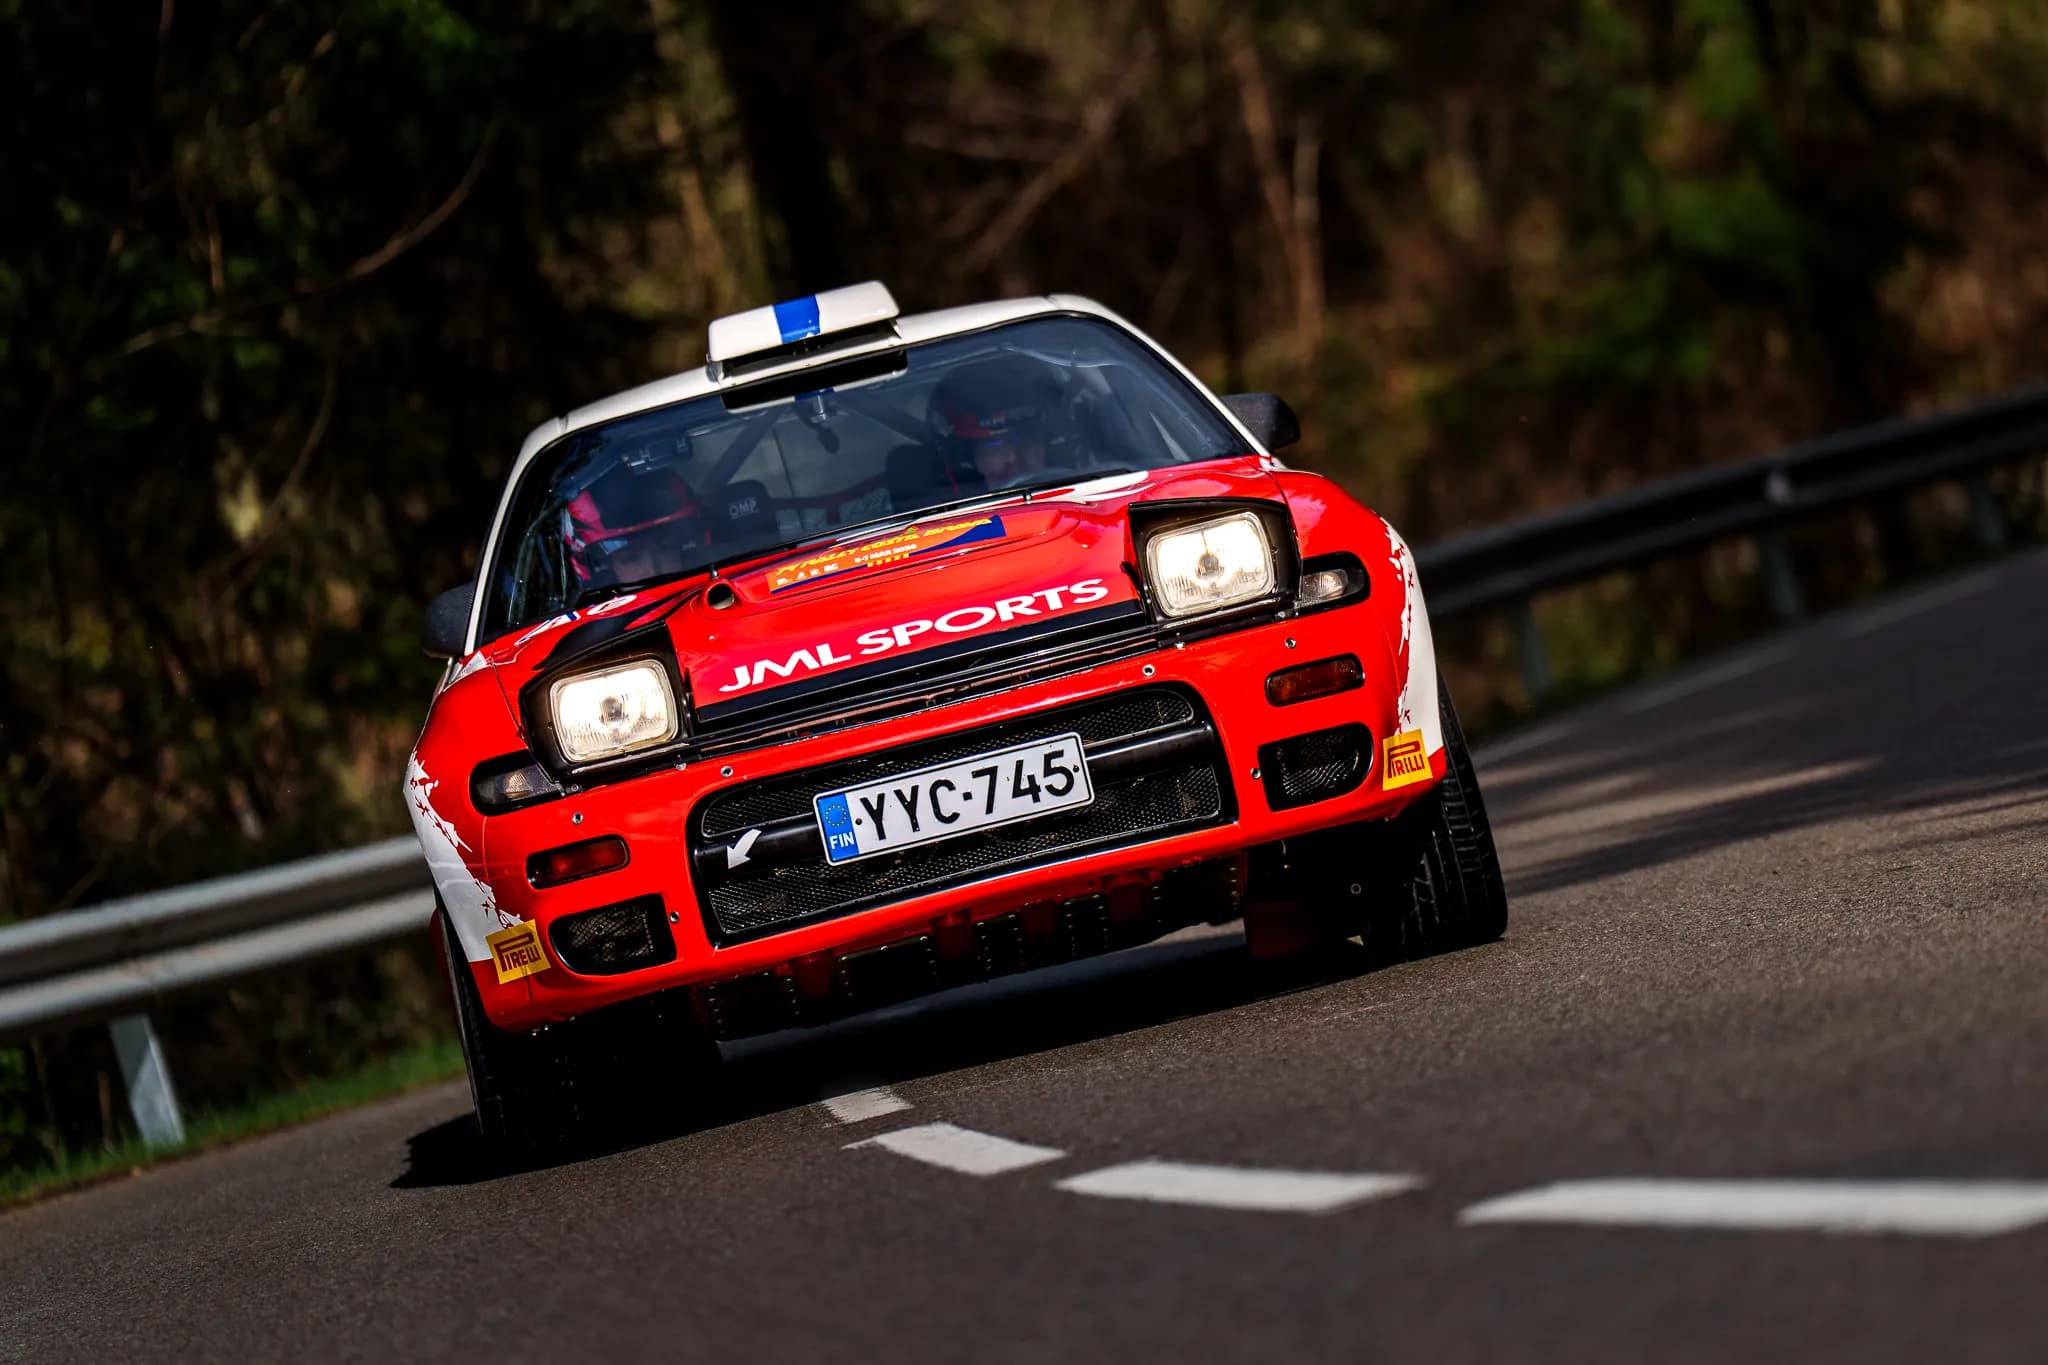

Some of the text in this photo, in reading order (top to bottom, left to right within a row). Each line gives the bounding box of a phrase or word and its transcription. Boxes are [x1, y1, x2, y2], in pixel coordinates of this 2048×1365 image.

[719, 578, 1108, 692] JML SPORTS
[829, 749, 1075, 850] FIN YYC-745
[493, 932, 541, 973] PIRELLI
